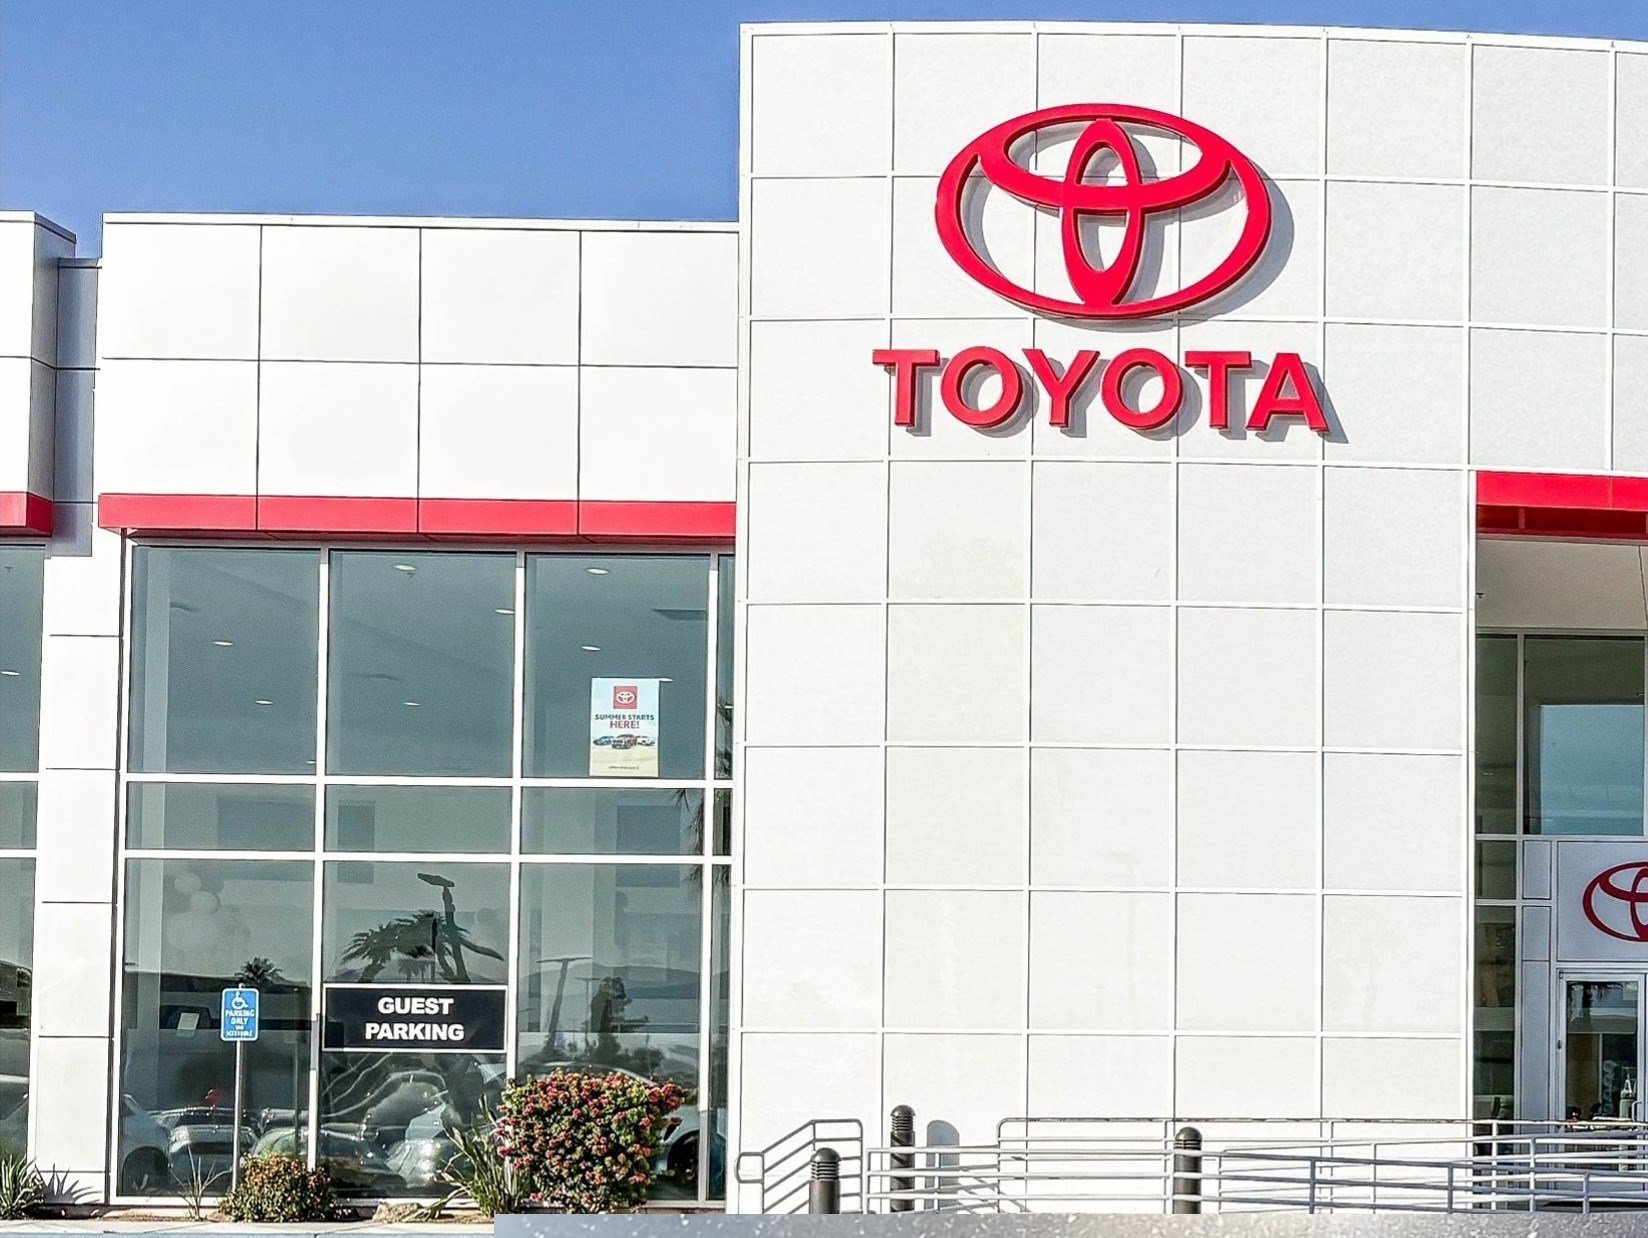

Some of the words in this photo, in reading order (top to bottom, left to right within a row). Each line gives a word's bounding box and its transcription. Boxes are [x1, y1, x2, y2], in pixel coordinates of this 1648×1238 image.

[872, 345, 1330, 433] TOYOTA
[609, 721, 640, 729] HERE!
[377, 997, 455, 1015] GUEST
[225, 1009, 255, 1017] PARKING
[230, 1017, 248, 1025] ONLY
[365, 1023, 465, 1040] PARKING
